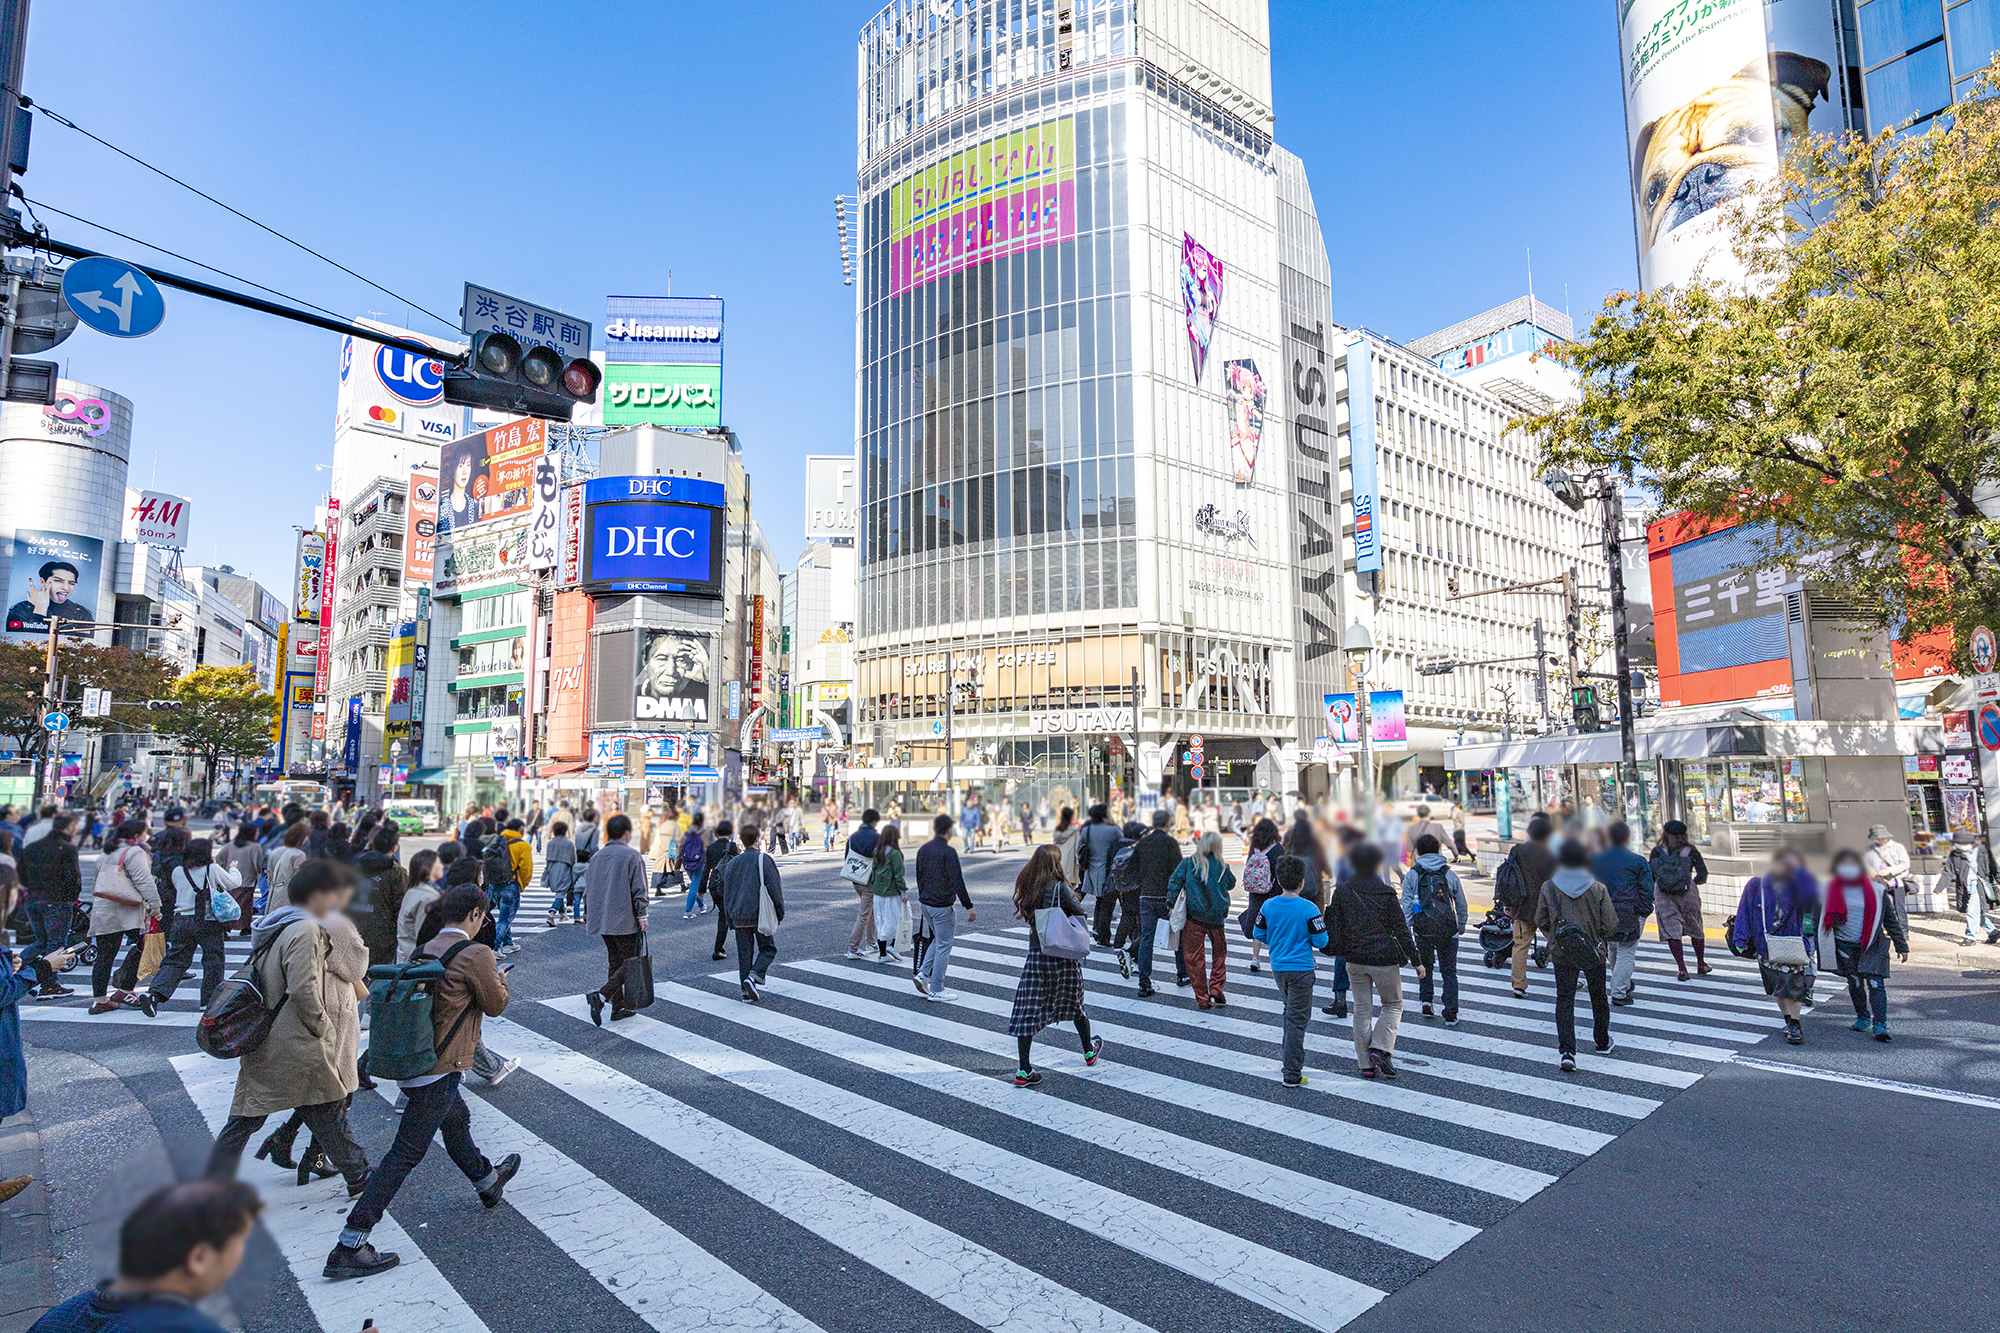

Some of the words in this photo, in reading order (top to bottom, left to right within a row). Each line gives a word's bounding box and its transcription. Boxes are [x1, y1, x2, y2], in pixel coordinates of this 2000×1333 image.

[1661, 43, 1681, 61] from
[1682, 32, 1697, 45] the
[1698, 12, 1738, 35] Experts
[475, 294, 581, 347] 渋谷駅前
[546, 339, 569, 358] Sta.
[383, 347, 443, 389] UC
[608, 382, 715, 407] サロンパス
[40, 419, 84, 434] SHIBUYA
[420, 419, 452, 436] VISA
[493, 426, 521, 453] 竹島
[526, 420, 541, 444] 宏
[628, 479, 672, 496] DHC
[837, 465, 853, 504] F
[1290, 320, 1338, 662] TSUTAYA
[131, 496, 183, 527] H&M
[532, 456, 558, 564] もんじゃ
[134, 527, 165, 539] 150m
[1354, 493, 1375, 562] SEIBU
[27, 546, 93, 562] 好きが、ここに。
[28, 536, 70, 548] みんなの
[606, 526, 695, 559] DHC
[22, 621, 49, 629] YouTube
[754, 597, 762, 652] クスリのことなら
[995, 651, 1057, 667] COFFEE
[1196, 657, 1271, 681] TSUTAYA
[752, 655, 762, 689] 三千里
[1033, 710, 1136, 733] TSUTAYA
[597, 738, 700, 758] 大盛書店
